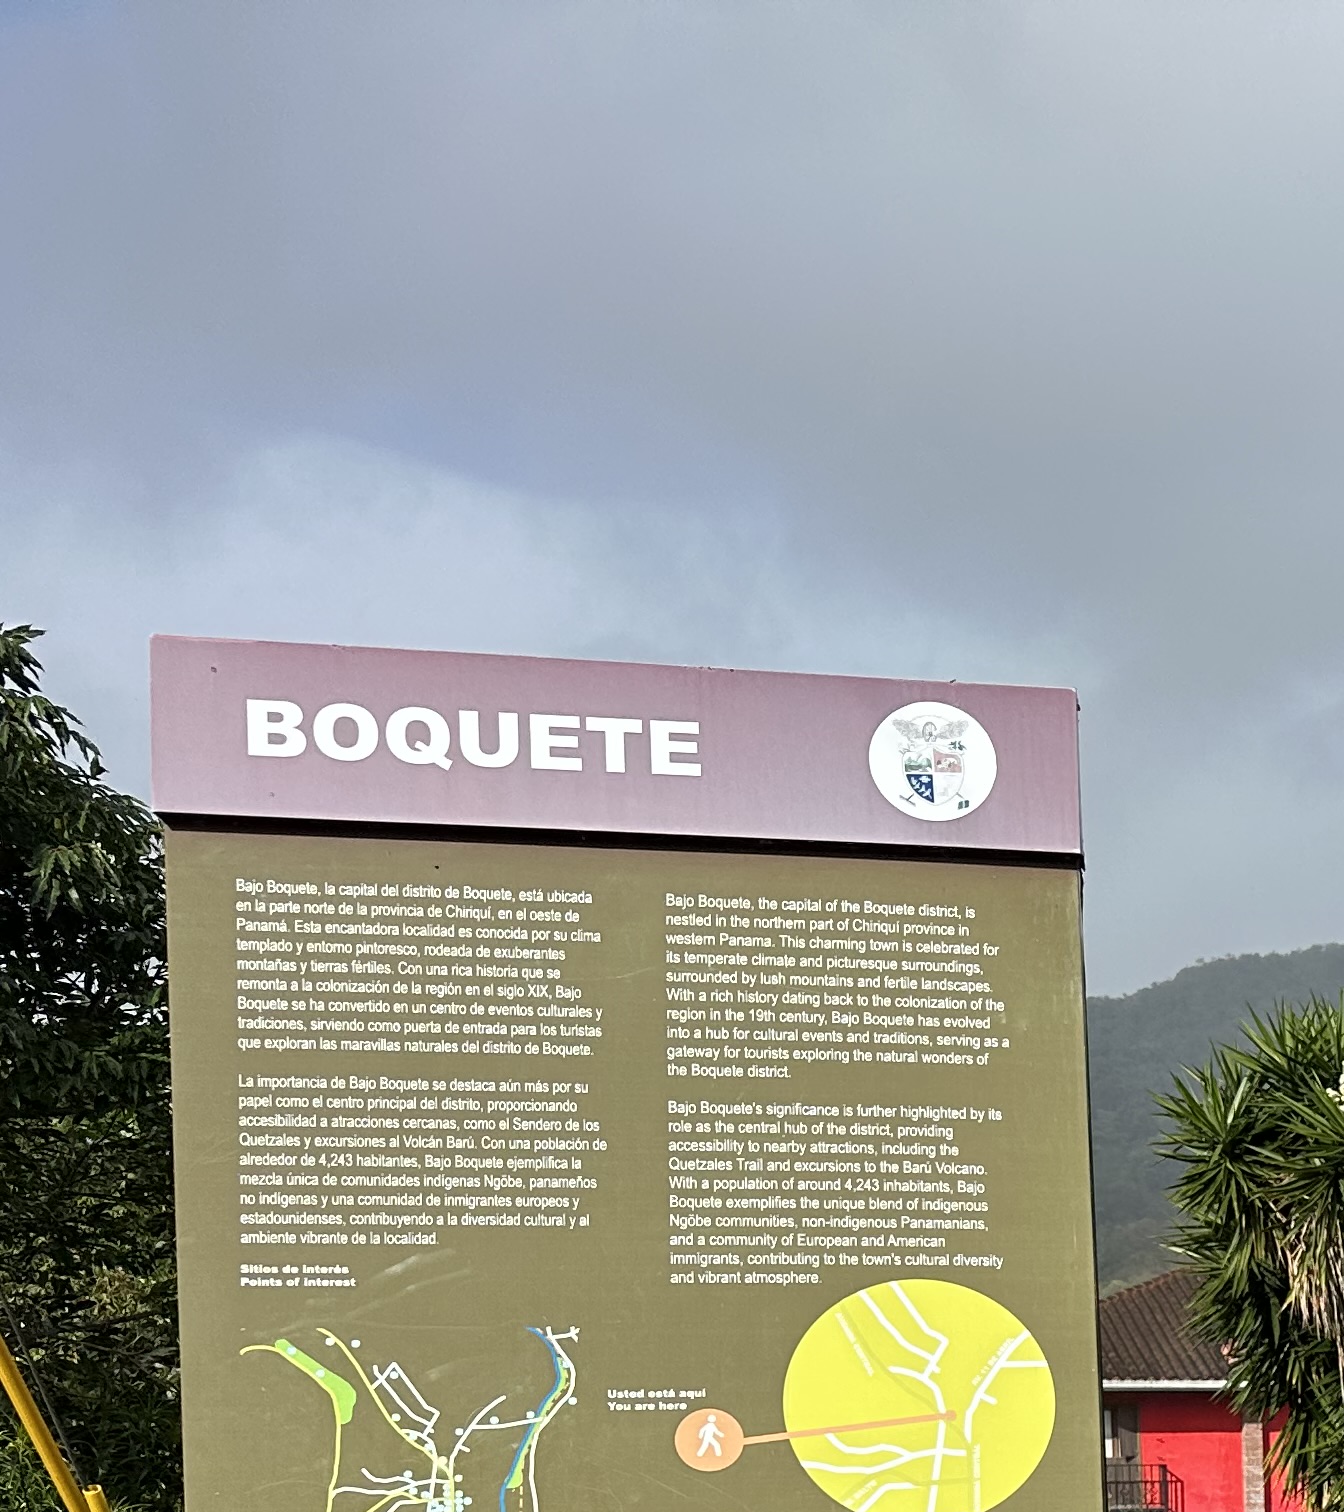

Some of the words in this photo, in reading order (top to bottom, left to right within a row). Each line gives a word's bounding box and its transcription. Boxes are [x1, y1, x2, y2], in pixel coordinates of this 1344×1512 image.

[246, 699, 702, 777] BOQUETE
[236, 878, 264, 896] Bajo
[266, 880, 321, 897] Boquete,
[324, 882, 336, 896] la
[338, 883, 378, 899] capital
[381, 883, 399, 897] del
[402, 884, 442, 899] distrito
[444, 885, 460, 899] de
[463, 885, 516, 903] Boquete,
[518, 889, 544, 902] está
[547, 890, 593, 904] ubicada
[666, 893, 695, 910] Bajo
[698, 894, 755, 911] Boquete,
[758, 897, 778, 910] the
[782, 898, 822, 914] capital
[825, 899, 839, 912] of
[840, 900, 861, 913] the
[864, 900, 915, 917] Boquete
[918, 904, 961, 920] district,
[966, 906, 976, 919] is
[294, 919, 322, 934] Esta
[324, 922, 400, 936] encantadora
[402, 923, 455, 938] localidad
[458, 927, 473, 938] es
[475, 926, 529, 940] conocida
[532, 930, 551, 943] por
[554, 930, 567, 942] su
[570, 928, 601, 943] clima
[666, 988, 695, 1002] With
[698, 992, 707, 1002] a
[710, 989, 733, 1003] rich
[737, 990, 779, 1007] history
[782, 991, 821, 1008] dating
[824, 992, 853, 1006] back
[856, 994, 869, 1007] to
[872, 994, 891, 1007] the
[894, 995, 967, 1010] colonization
[970, 998, 983, 1011] of
[985, 998, 1005, 1012] the
[238, 1094, 273, 1110] papel
[275, 1097, 310, 1108] como
[312, 1095, 323, 1108] el
[326, 1096, 365, 1109] centro
[367, 1096, 417, 1113] principal
[420, 1096, 438, 1110] del
[441, 1097, 483, 1113] distrito,
[487, 1098, 577, 1114] proporcionando
[239, 1152, 298, 1166] alrededor
[300, 1153, 316, 1167] de
[318, 1153, 353, 1169] 4,243
[356, 1154, 421, 1169] habitantes,
[425, 1154, 452, 1171] Bajo
[455, 1154, 504, 1171] Boquete
[506, 1156, 569, 1172] ejemplifica
[572, 1156, 582, 1170] la
[668, 1157, 733, 1171] Quetzales
[736, 1158, 763, 1172] Trail
[766, 1159, 791, 1172] and
[794, 1160, 861, 1173] excursions
[864, 1161, 877, 1173] to
[880, 1160, 899, 1174] the
[903, 1160, 932, 1174] Barú
[935, 1161, 987, 1175] Volcano.
[668, 1176, 697, 1189] With
[701, 1179, 710, 1190] a
[713, 1176, 779, 1193] population
[782, 1177, 795, 1191] of
[797, 1178, 841, 1191] around
[844, 1178, 880, 1193] 4,243
[883, 1179, 953, 1194] inhabitants,
[957, 1180, 985, 1196] Bajo
[670, 1233, 694, 1246] and
[697, 1236, 705, 1246] a
[709, 1233, 778, 1250] community
[781, 1233, 795, 1247] of
[797, 1233, 857, 1250] European
[860, 1234, 885, 1247] and
[887, 1234, 946, 1248] American
[282, 1264, 299, 1274] de
[240, 1277, 283, 1287] Points
[286, 1277, 301, 1287] of
[608, 1389, 645, 1399] Usted
[648, 1389, 676, 1398] está
[678, 1388, 706, 1400] aquí
[607, 1402, 631, 1411] You
[634, 1403, 656, 1411] are
[658, 1401, 687, 1411] here
